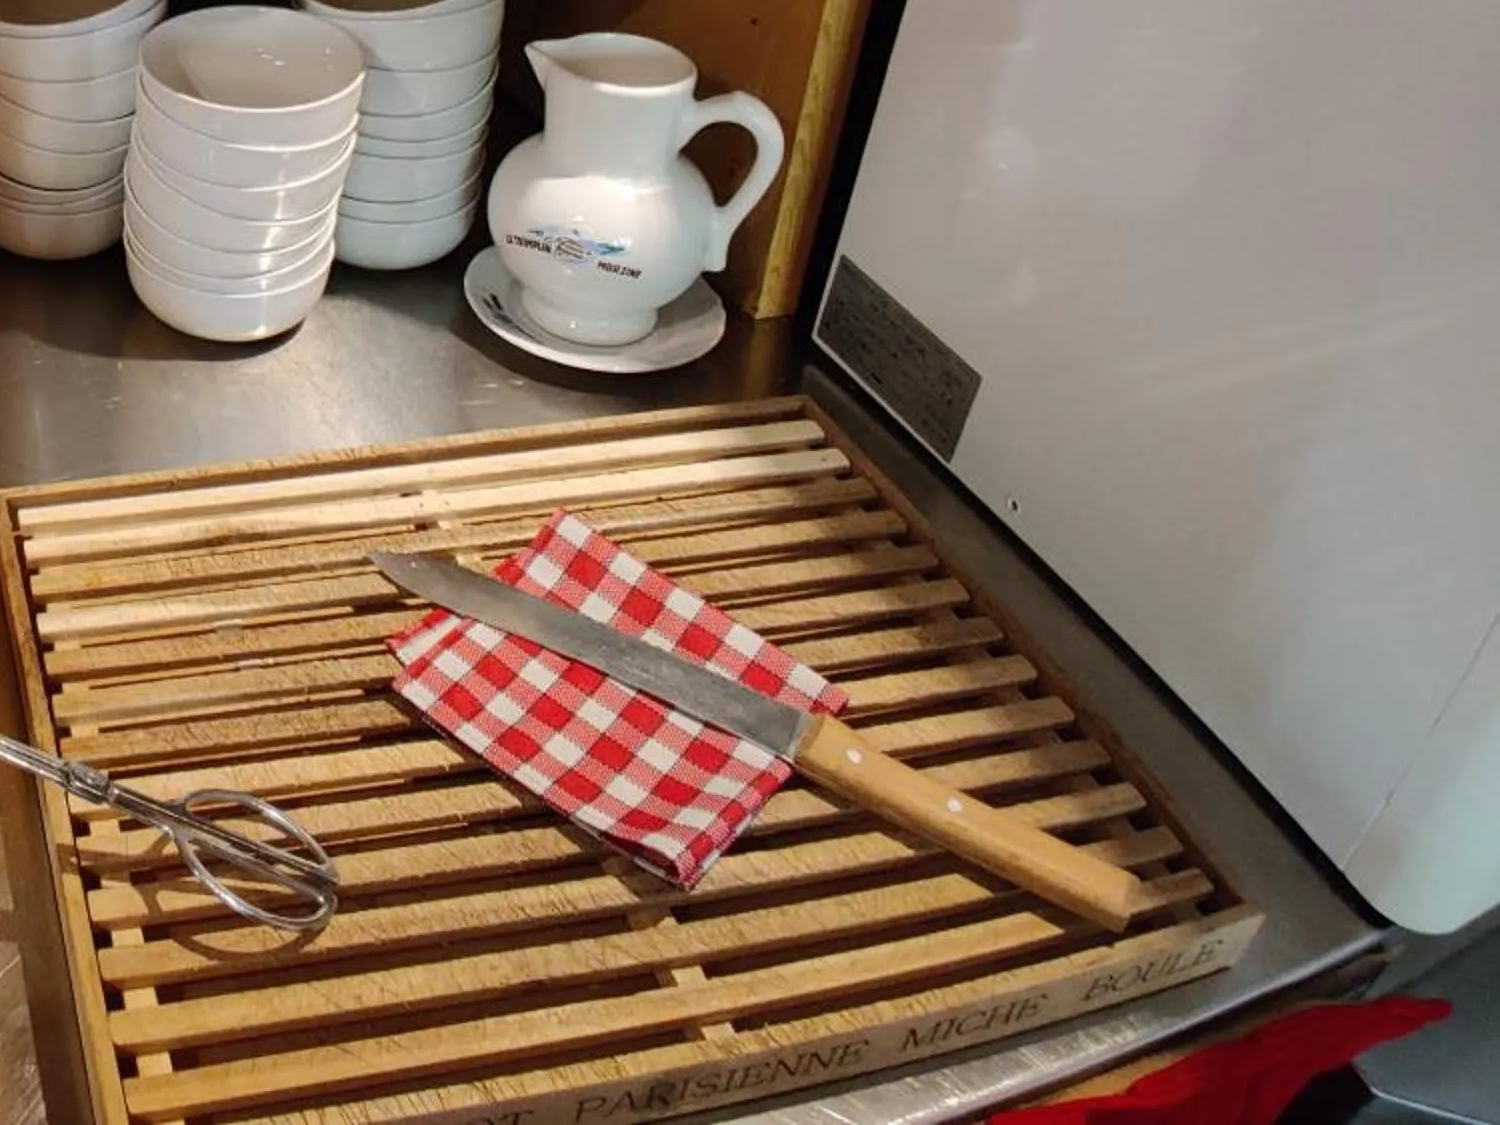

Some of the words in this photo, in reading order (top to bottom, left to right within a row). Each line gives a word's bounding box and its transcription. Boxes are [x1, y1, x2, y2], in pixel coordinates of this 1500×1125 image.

[1081, 938, 1225, 1003] BOULE
[900, 992, 1048, 1053] MICHE
[575, 1038, 870, 1122] PARISIENNE
